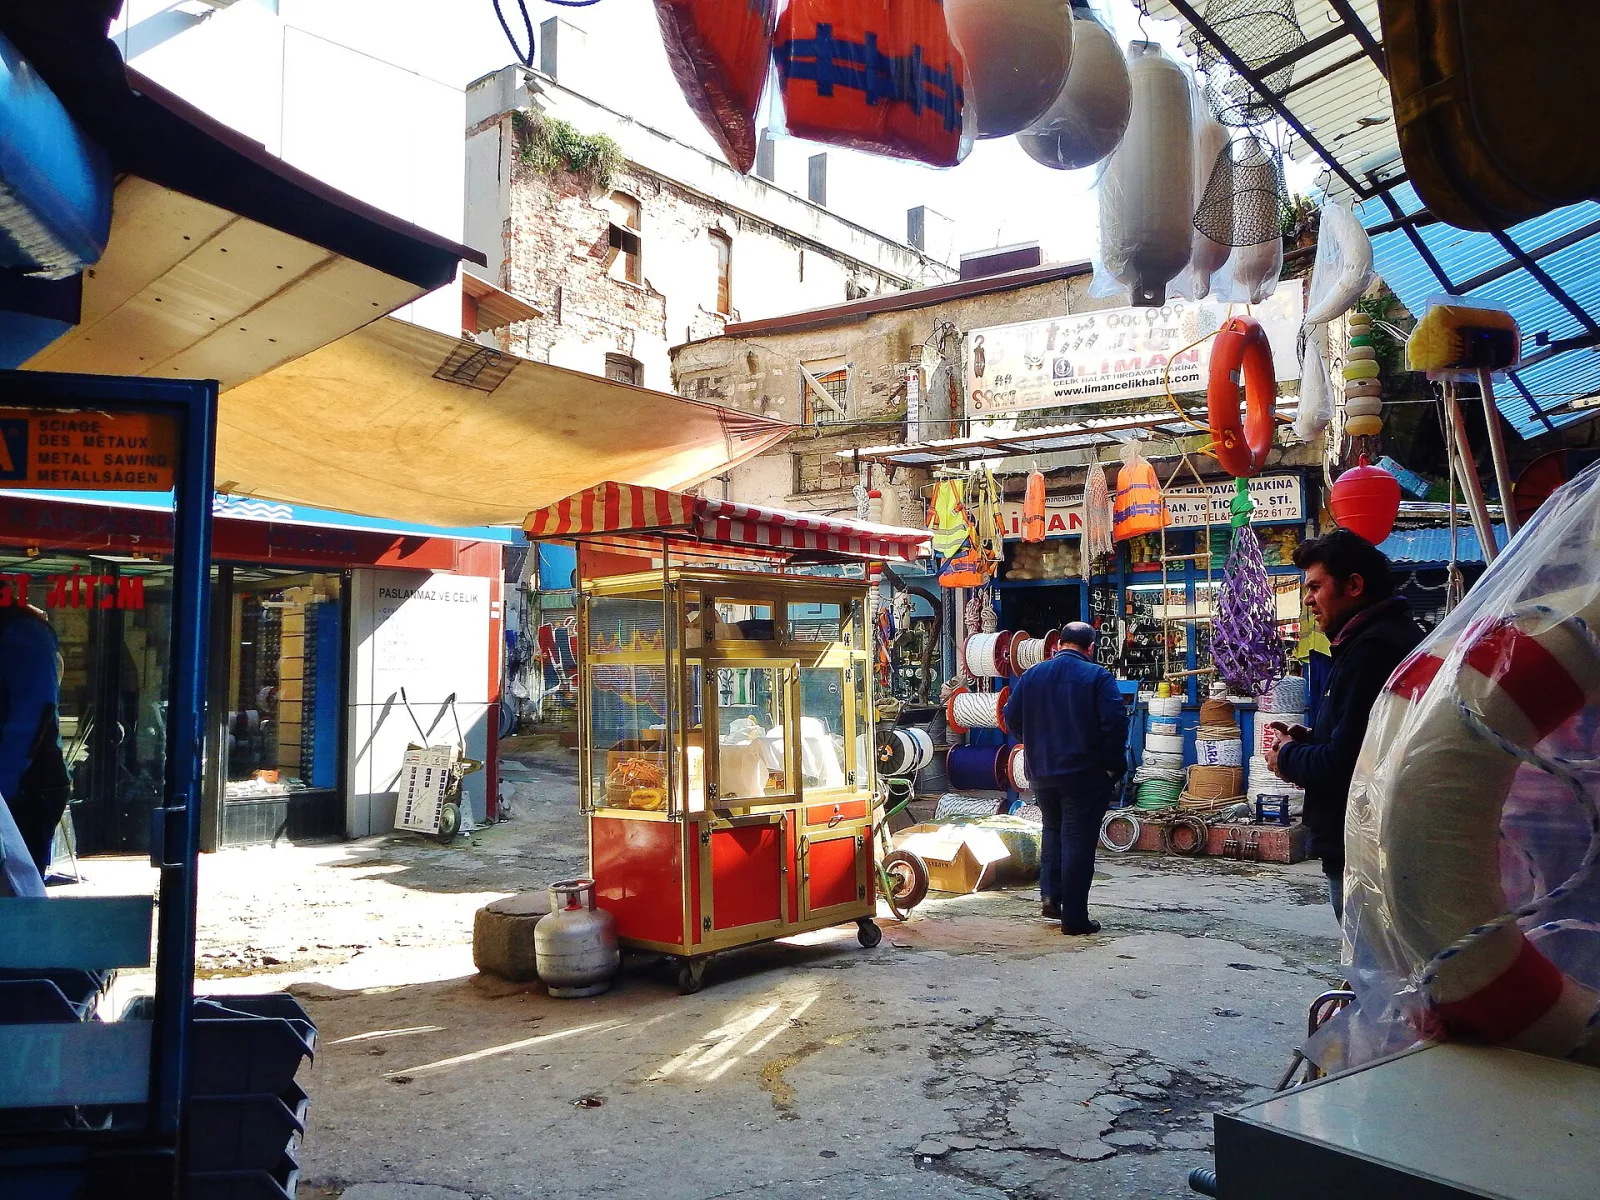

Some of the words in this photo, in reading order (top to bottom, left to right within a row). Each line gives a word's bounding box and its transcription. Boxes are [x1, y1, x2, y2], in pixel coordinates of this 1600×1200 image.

[1077, 349, 1199, 377] LİMAN
[1053, 378, 1079, 388] ÇELİK
[1081, 374, 1111, 384] HALAT
[1113, 369, 1158, 380] HIRDAVAT
[1160, 363, 1198, 374] MAKİNA
[1054, 373, 1200, 398] www.limancelikhalat.com
[39, 419, 101, 433] SCIAGE
[38, 434, 70, 447] DES
[38, 452, 91, 466] METAL
[103, 453, 168, 467] SAWING
[1186, 484, 1237, 495] HIRDAVA
[1248, 478, 1293, 491] MAKİNA
[1194, 503, 1207, 511] ve
[1174, 515, 1184, 524] 61
[1271, 508, 1283, 518] 61
[1285, 507, 1298, 516] 72
[379, 587, 436, 602] PASLANMAZ
[438, 591, 451, 602] VE
